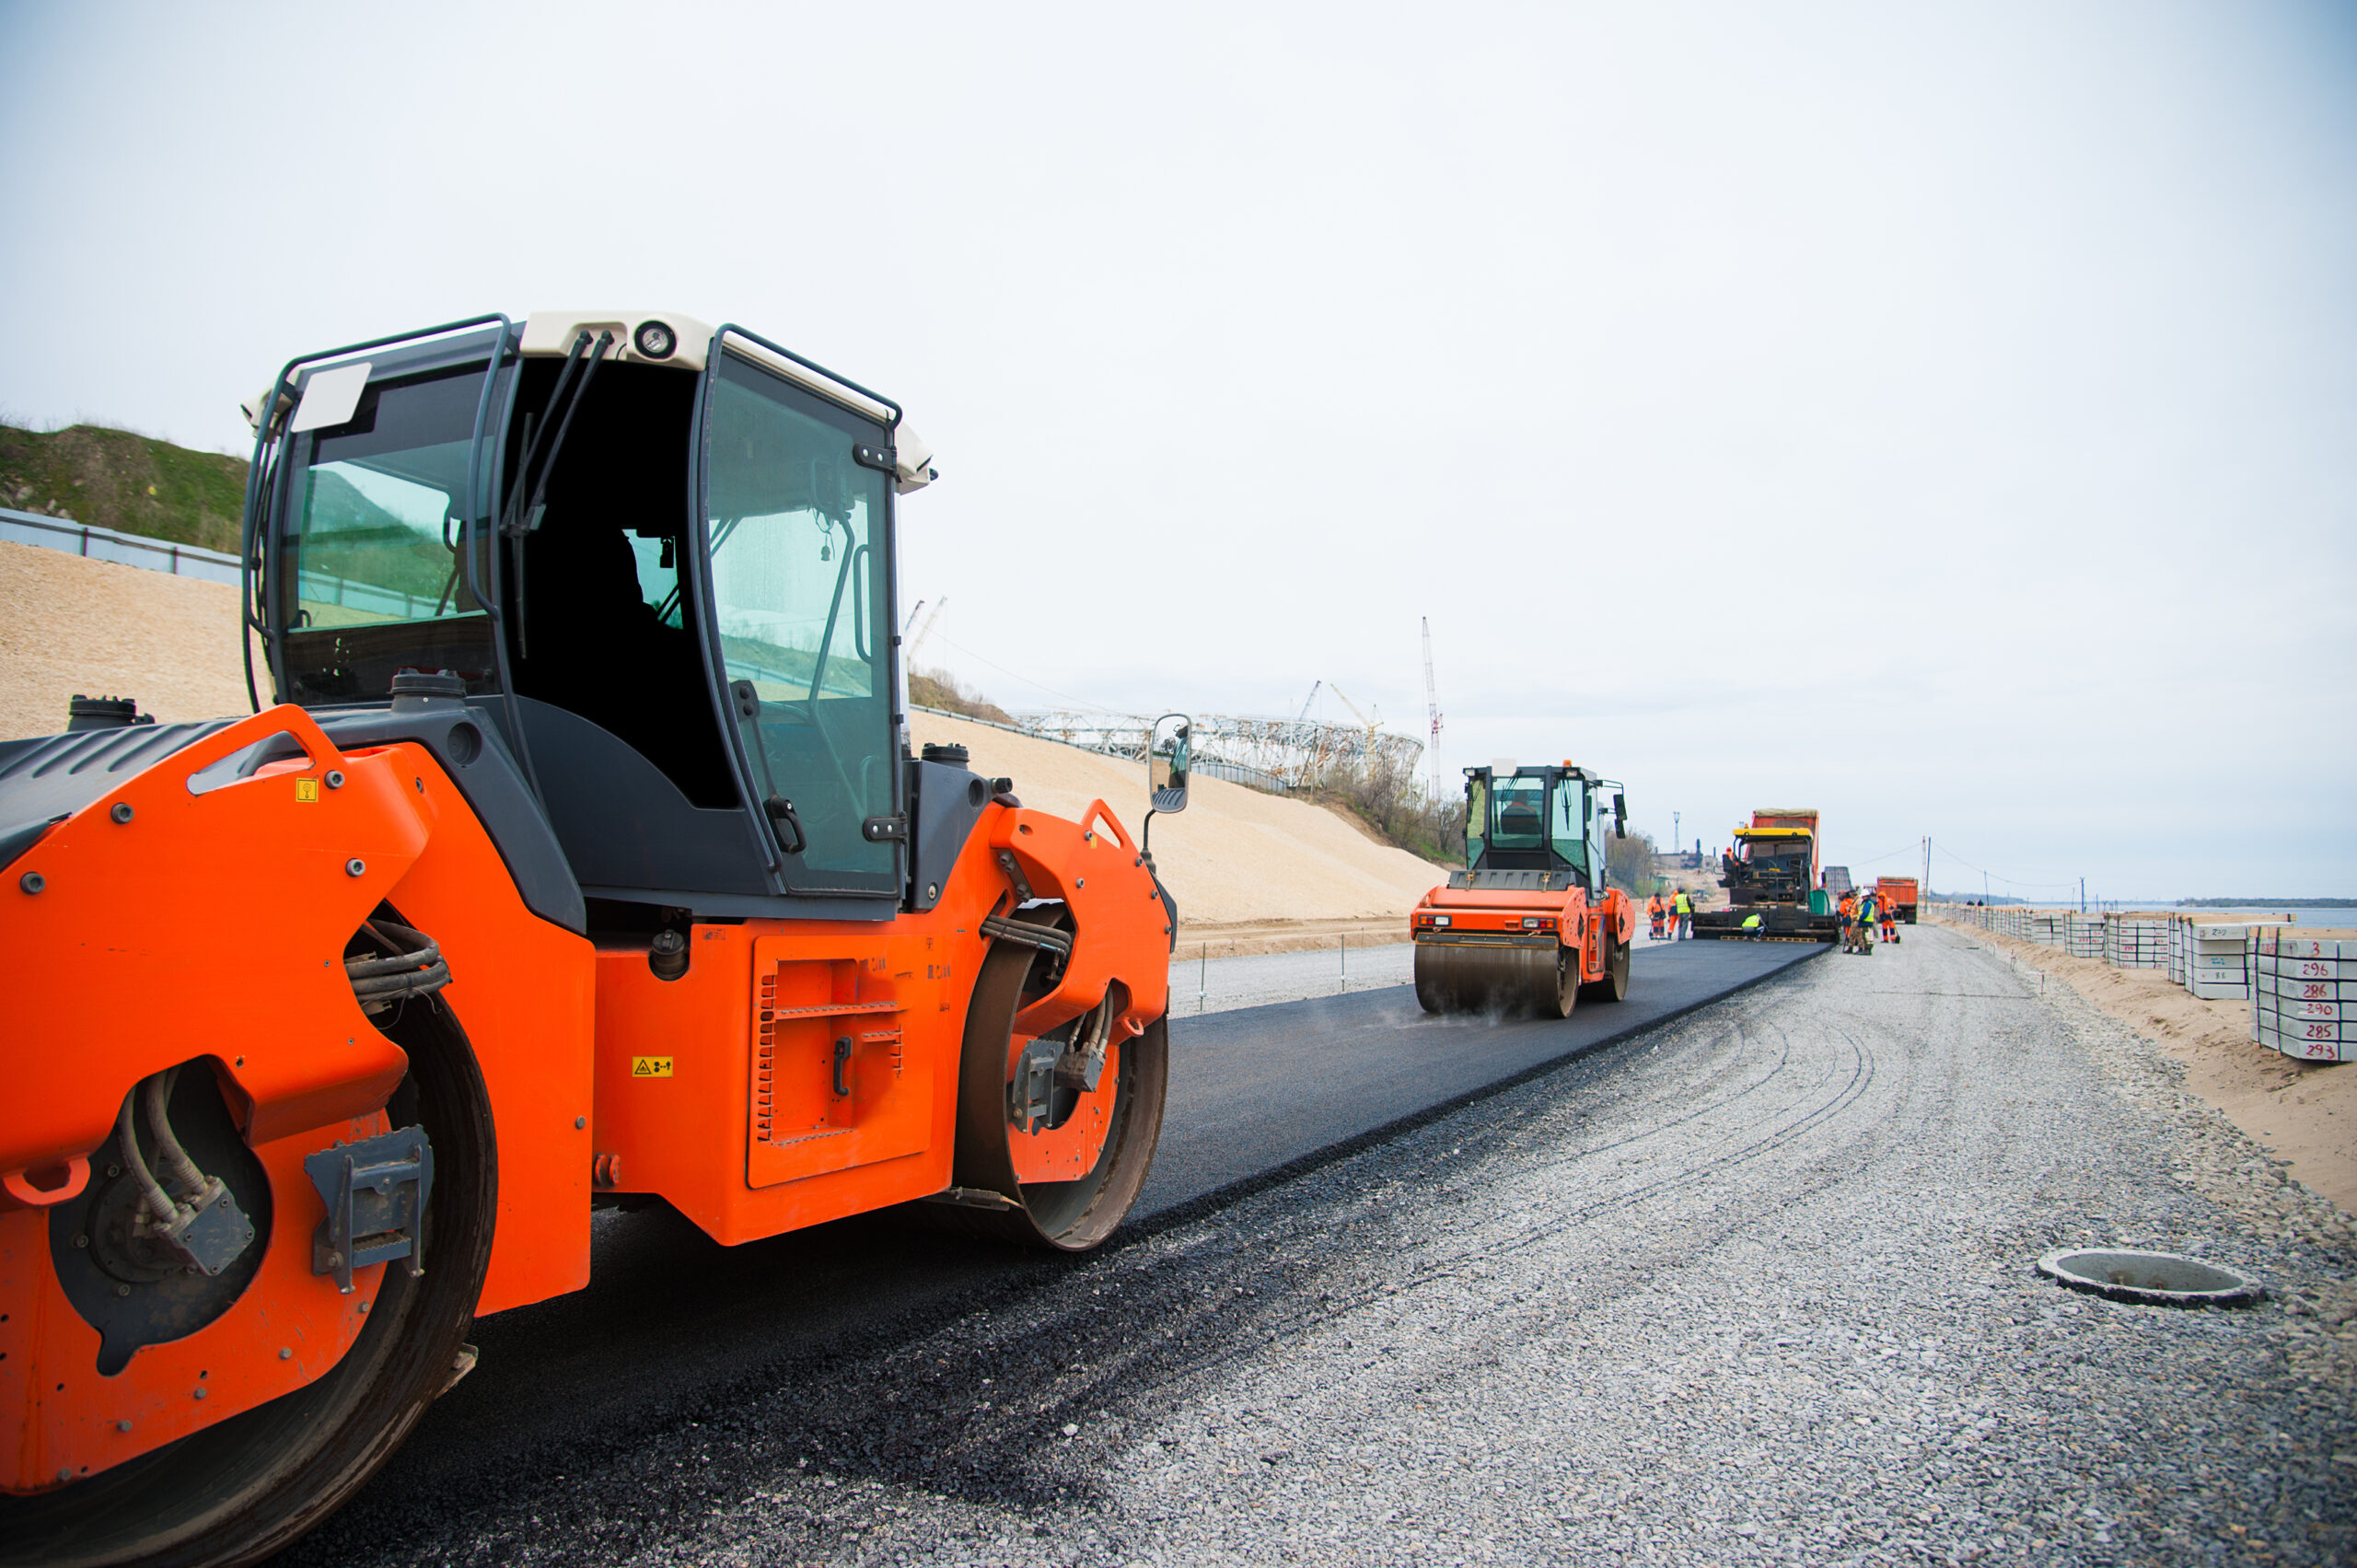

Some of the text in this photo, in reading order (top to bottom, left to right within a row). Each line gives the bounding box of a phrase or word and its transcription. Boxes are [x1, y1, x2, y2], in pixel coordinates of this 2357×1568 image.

[2313, 941, 2320, 957] 3
[2303, 962, 2328, 976] 296
[2303, 983, 2328, 998] 286
[2306, 1003, 2333, 1016] 290
[2306, 1024, 2333, 1039] 285
[2305, 1044, 2335, 1060] 293
